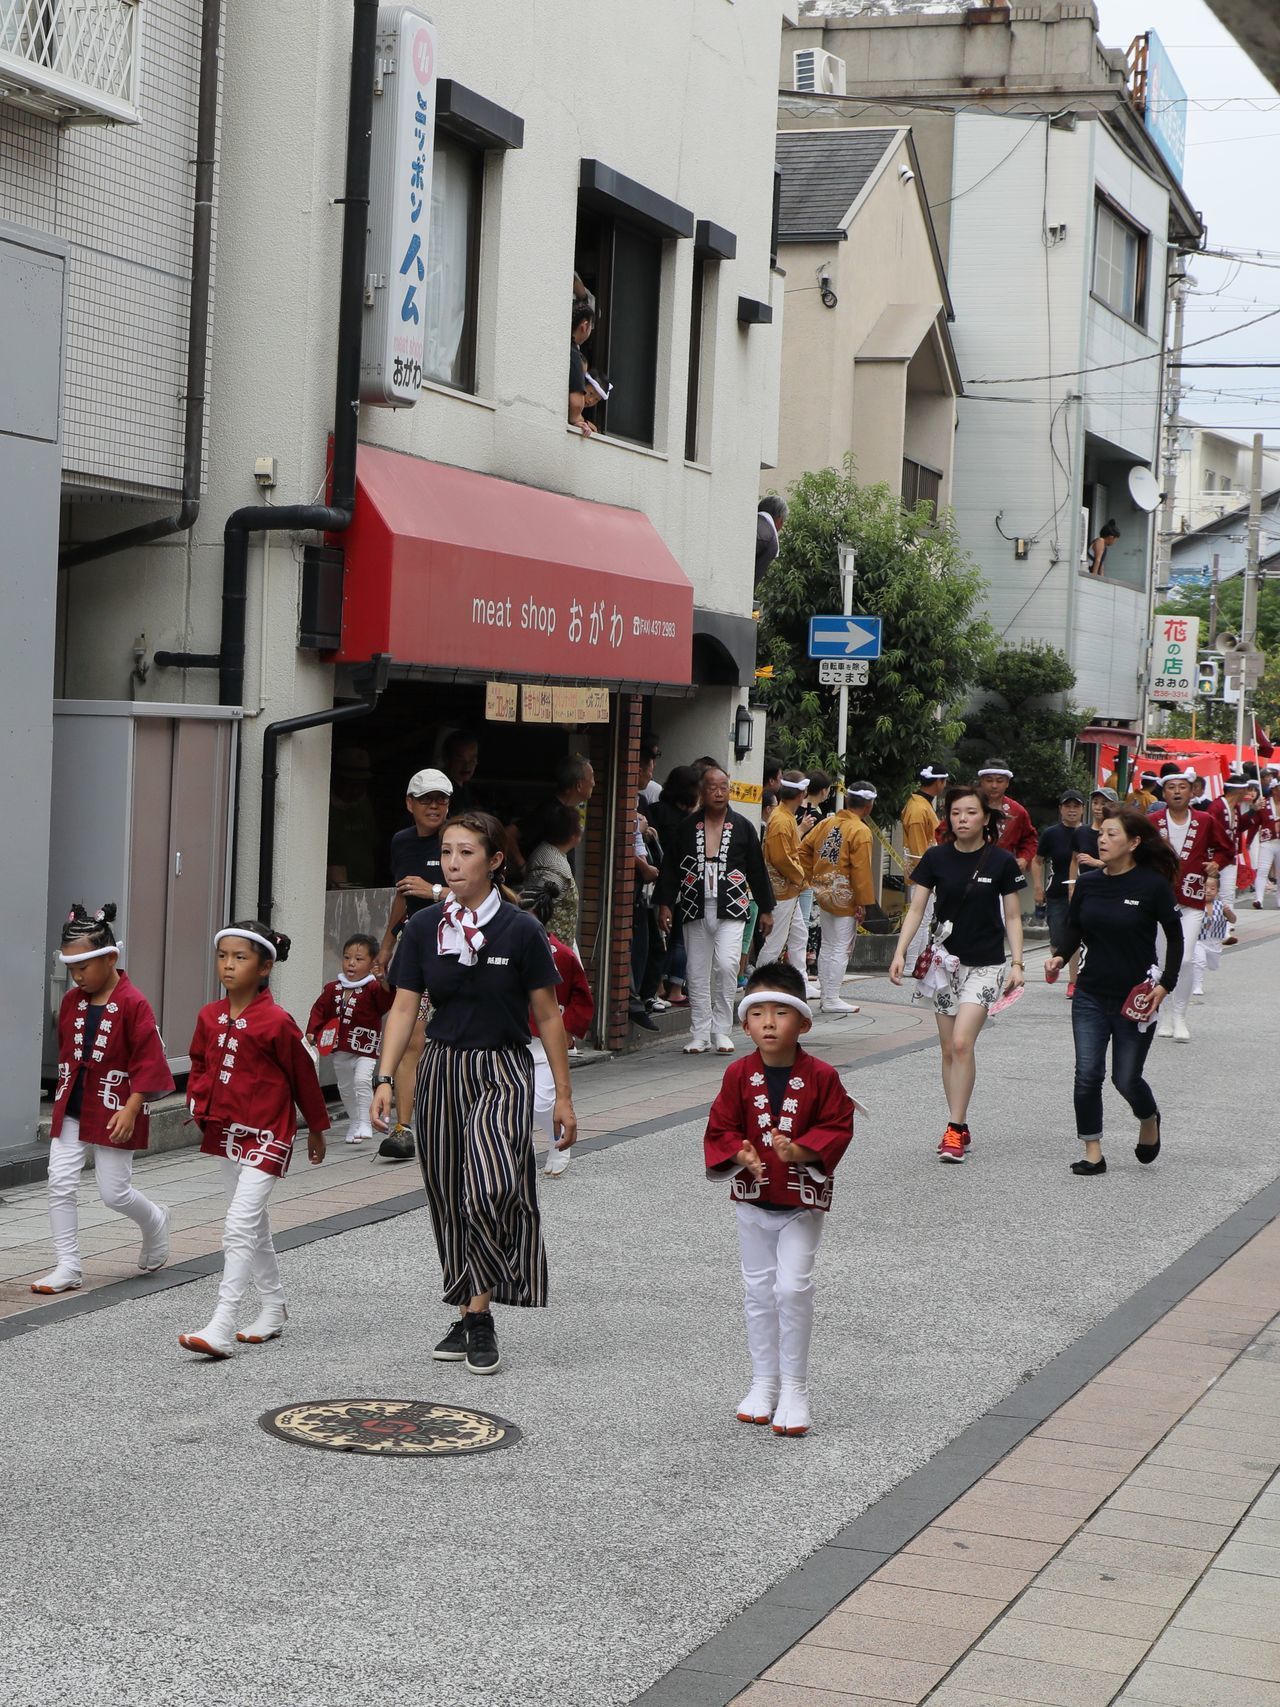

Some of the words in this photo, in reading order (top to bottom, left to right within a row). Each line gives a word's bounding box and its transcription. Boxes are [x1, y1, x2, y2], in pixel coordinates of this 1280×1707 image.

[393, 355, 422, 390] おがわ
[472, 596, 512, 628] meat
[521, 595, 556, 636] shop
[568, 598, 624, 648] おがわ
[821, 662, 866, 671] 自転車を除く
[1163, 619, 1188, 675] 花の店
[821, 671, 867, 684] ここまで
[1154, 678, 1189, 689] おおの
[91, 1019, 113, 1063] 紙屋町
[219, 1036, 239, 1085] 紙屋町
[778, 1097, 799, 1142] 紙屋
